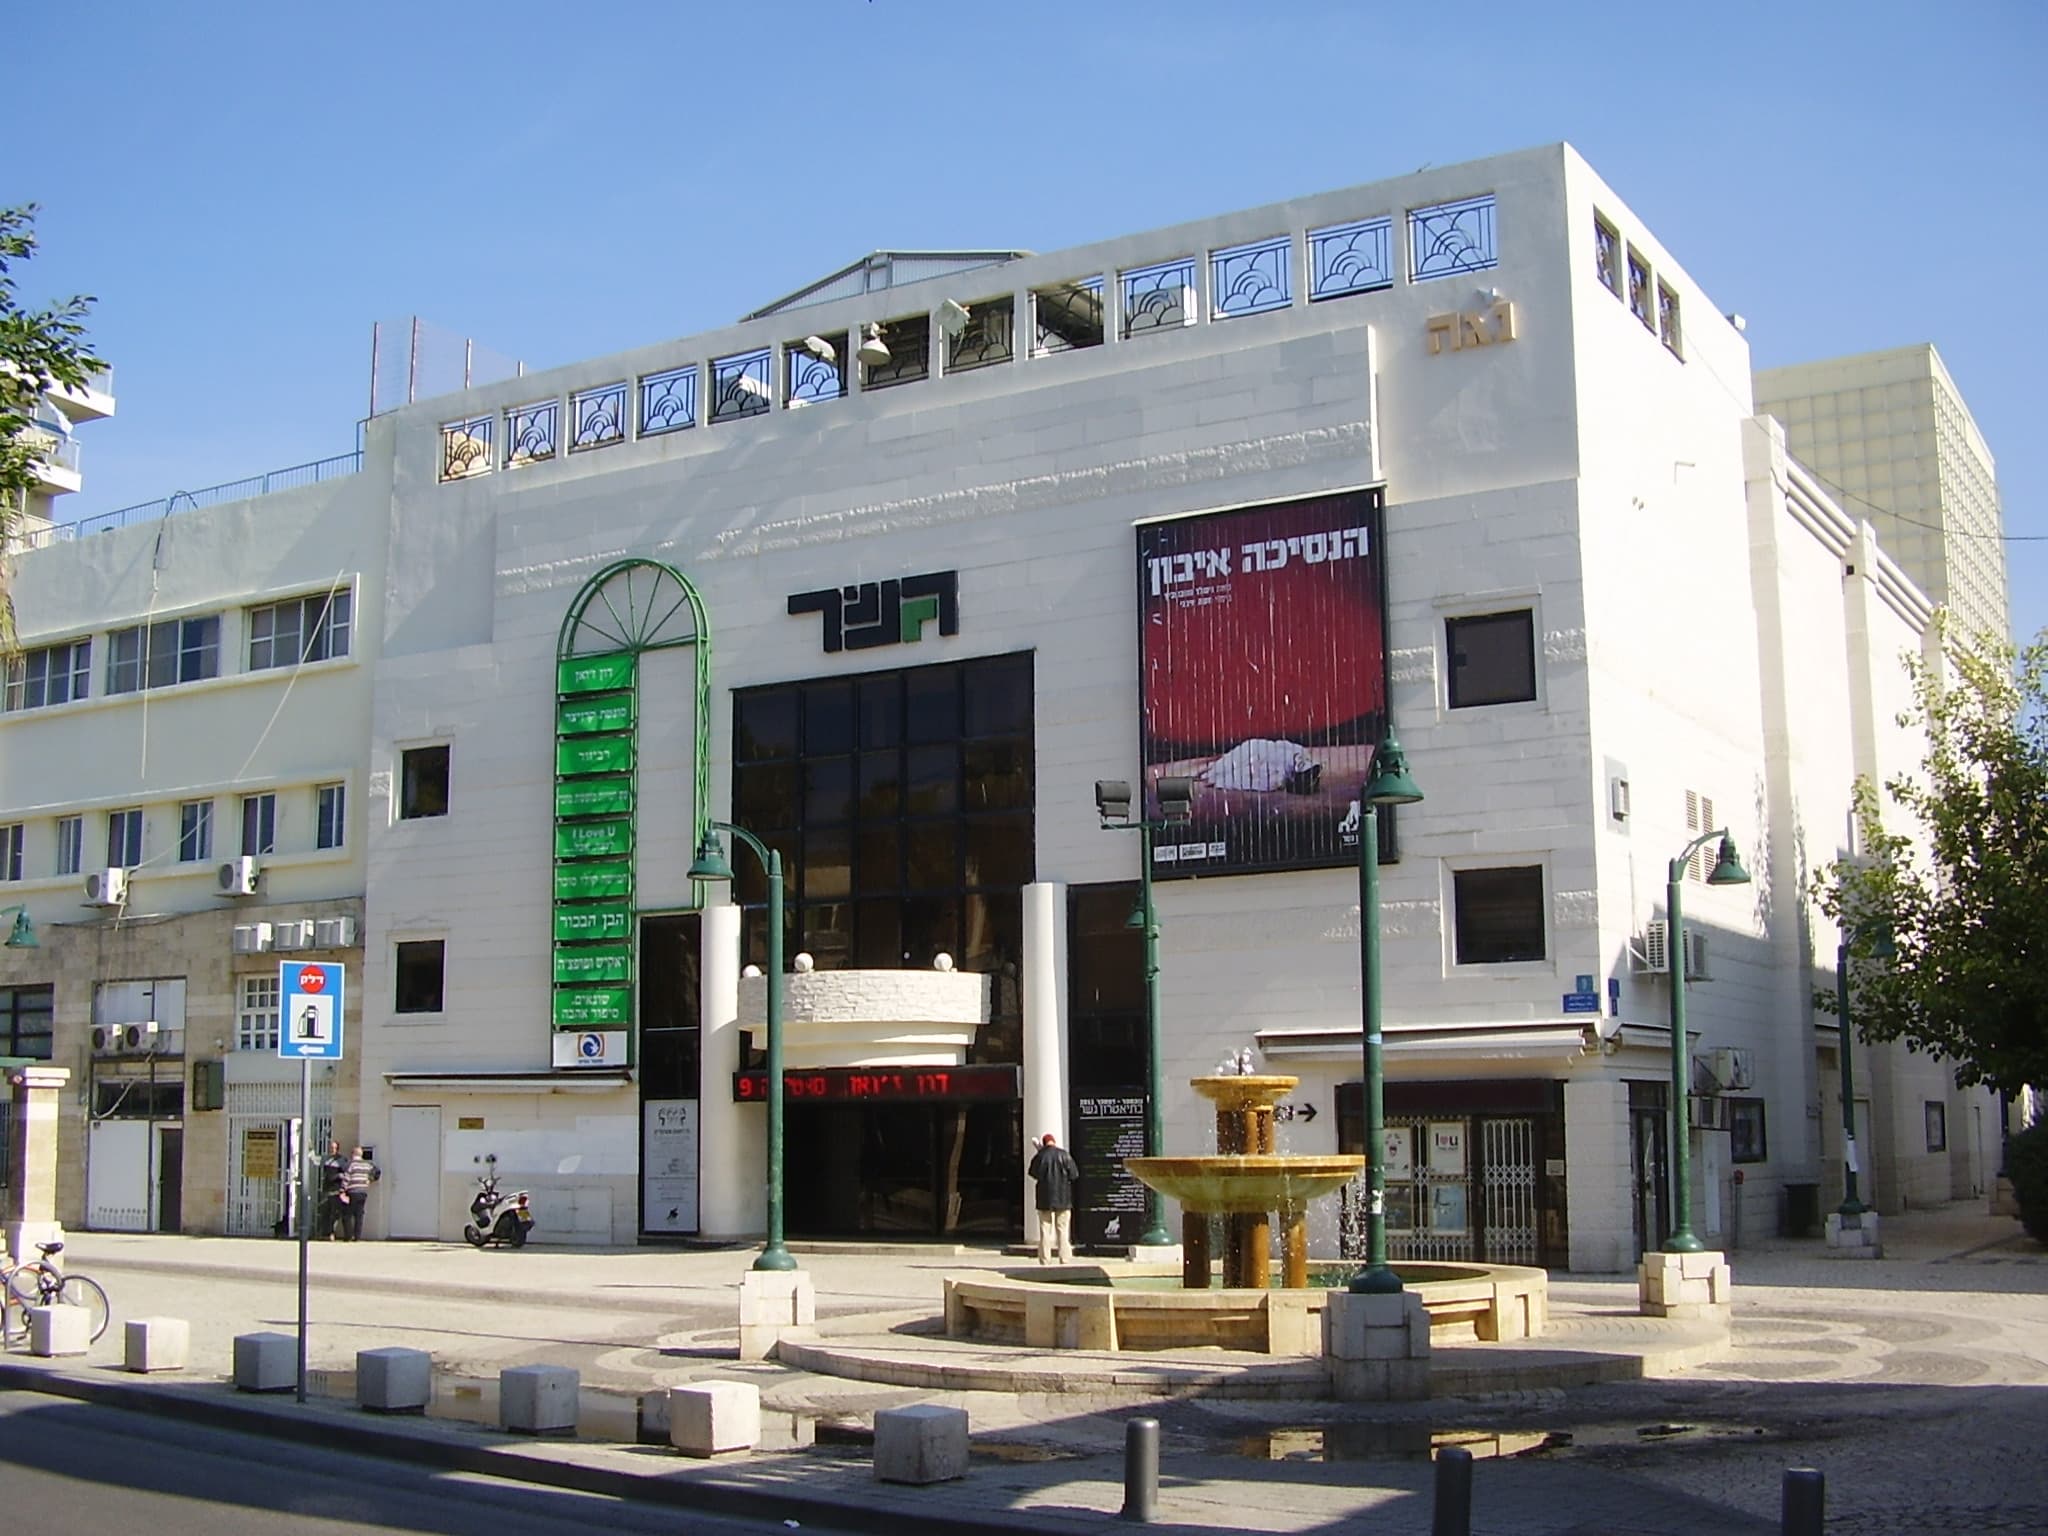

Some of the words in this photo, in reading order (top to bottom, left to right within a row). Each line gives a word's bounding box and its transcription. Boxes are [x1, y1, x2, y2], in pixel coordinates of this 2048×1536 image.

[1241, 527, 1370, 574] הנסיכה
[1148, 547, 1233, 597] איבון
[787, 569, 959, 654] גשר
[599, 667, 613, 681] דון
[578, 749, 611, 761] רביזור
[572, 829, 577, 839] I
[579, 827, 605, 839] Love
[607, 825, 616, 837] U
[559, 914, 596, 928] הבכור
[602, 913, 624, 930] הבן
[300, 973, 324, 985] דלק
[561, 1009, 589, 1020] אהבה
[591, 1008, 620, 1019] סיפור
[1080, 1104, 1099, 1115] גשר
[1100, 1103, 1144, 1117] בתיאטרון
